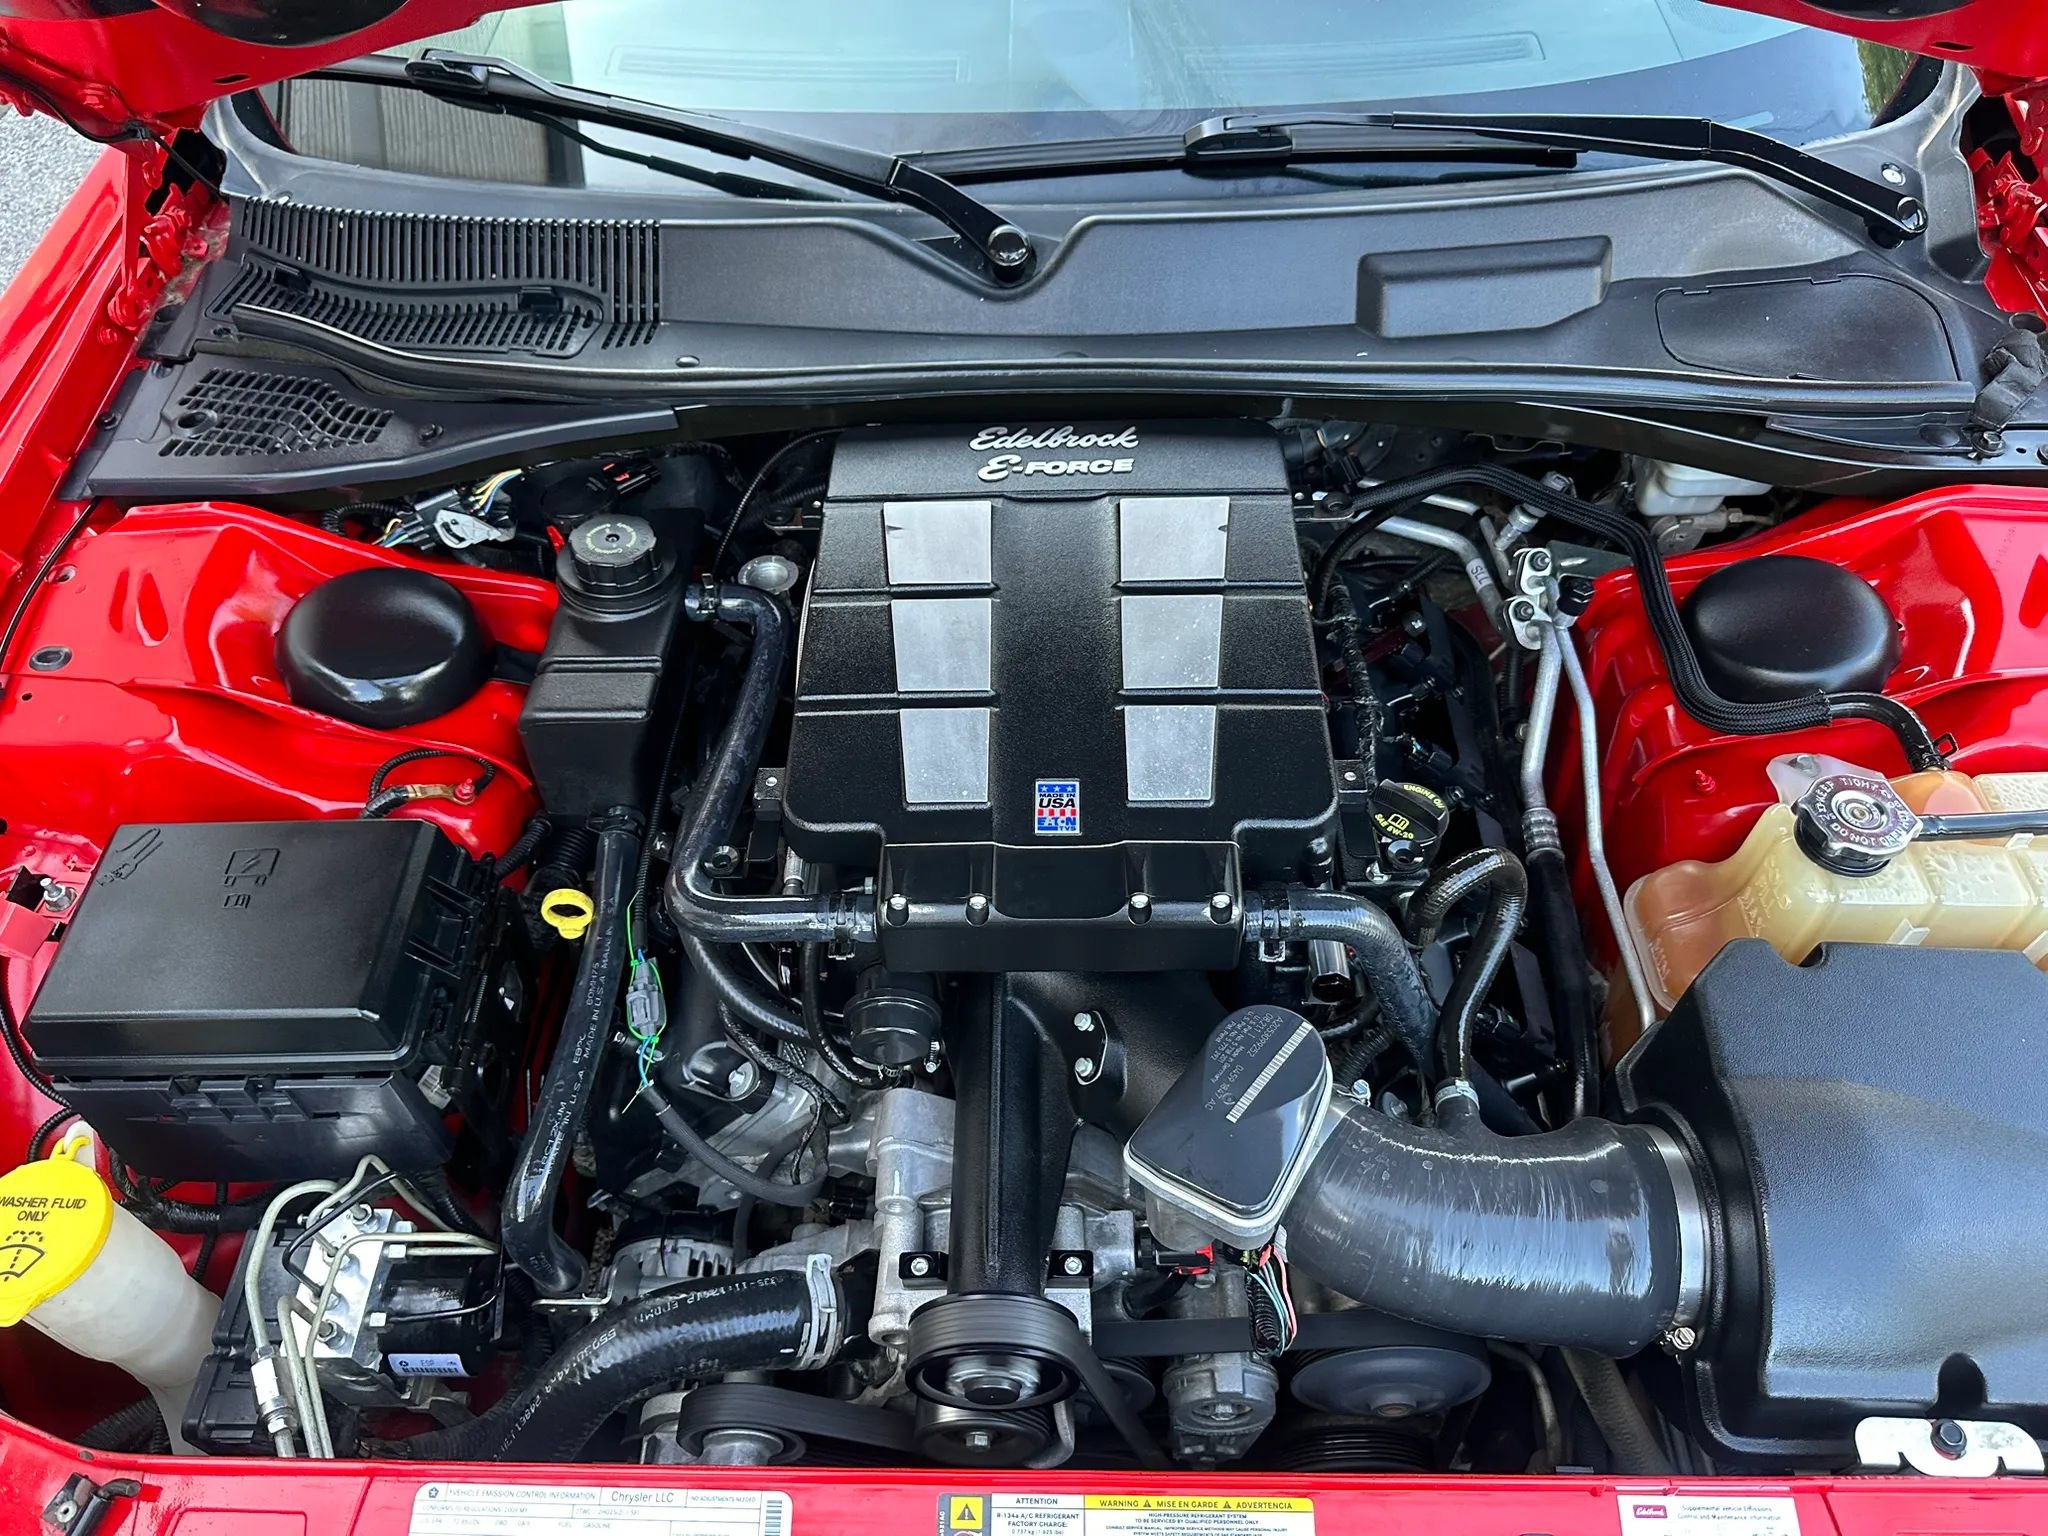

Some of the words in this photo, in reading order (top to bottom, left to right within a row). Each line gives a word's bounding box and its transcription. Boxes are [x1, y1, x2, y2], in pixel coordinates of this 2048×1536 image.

[969, 425, 1139, 450] Edelbrock
[977, 453, 1135, 482] E-FORCE
[1403, 784, 1436, 802] ENGINE
[1038, 798, 1076, 808] USA
[1374, 813, 1390, 828] SAE
[1386, 825, 1415, 841] 5W-20
[583, 1023, 597, 1058] MADE
[591, 1008, 599, 1020] IN
[0, 1196, 48, 1208] WASHER
[51, 1197, 87, 1209] FLUID
[17, 1210, 49, 1222] ONLY
[482, 1489, 515, 1498] EMISSION
[516, 1490, 548, 1498] CONTROL
[611, 1490, 653, 1504] Chrysler
[655, 1492, 675, 1503] LLC
